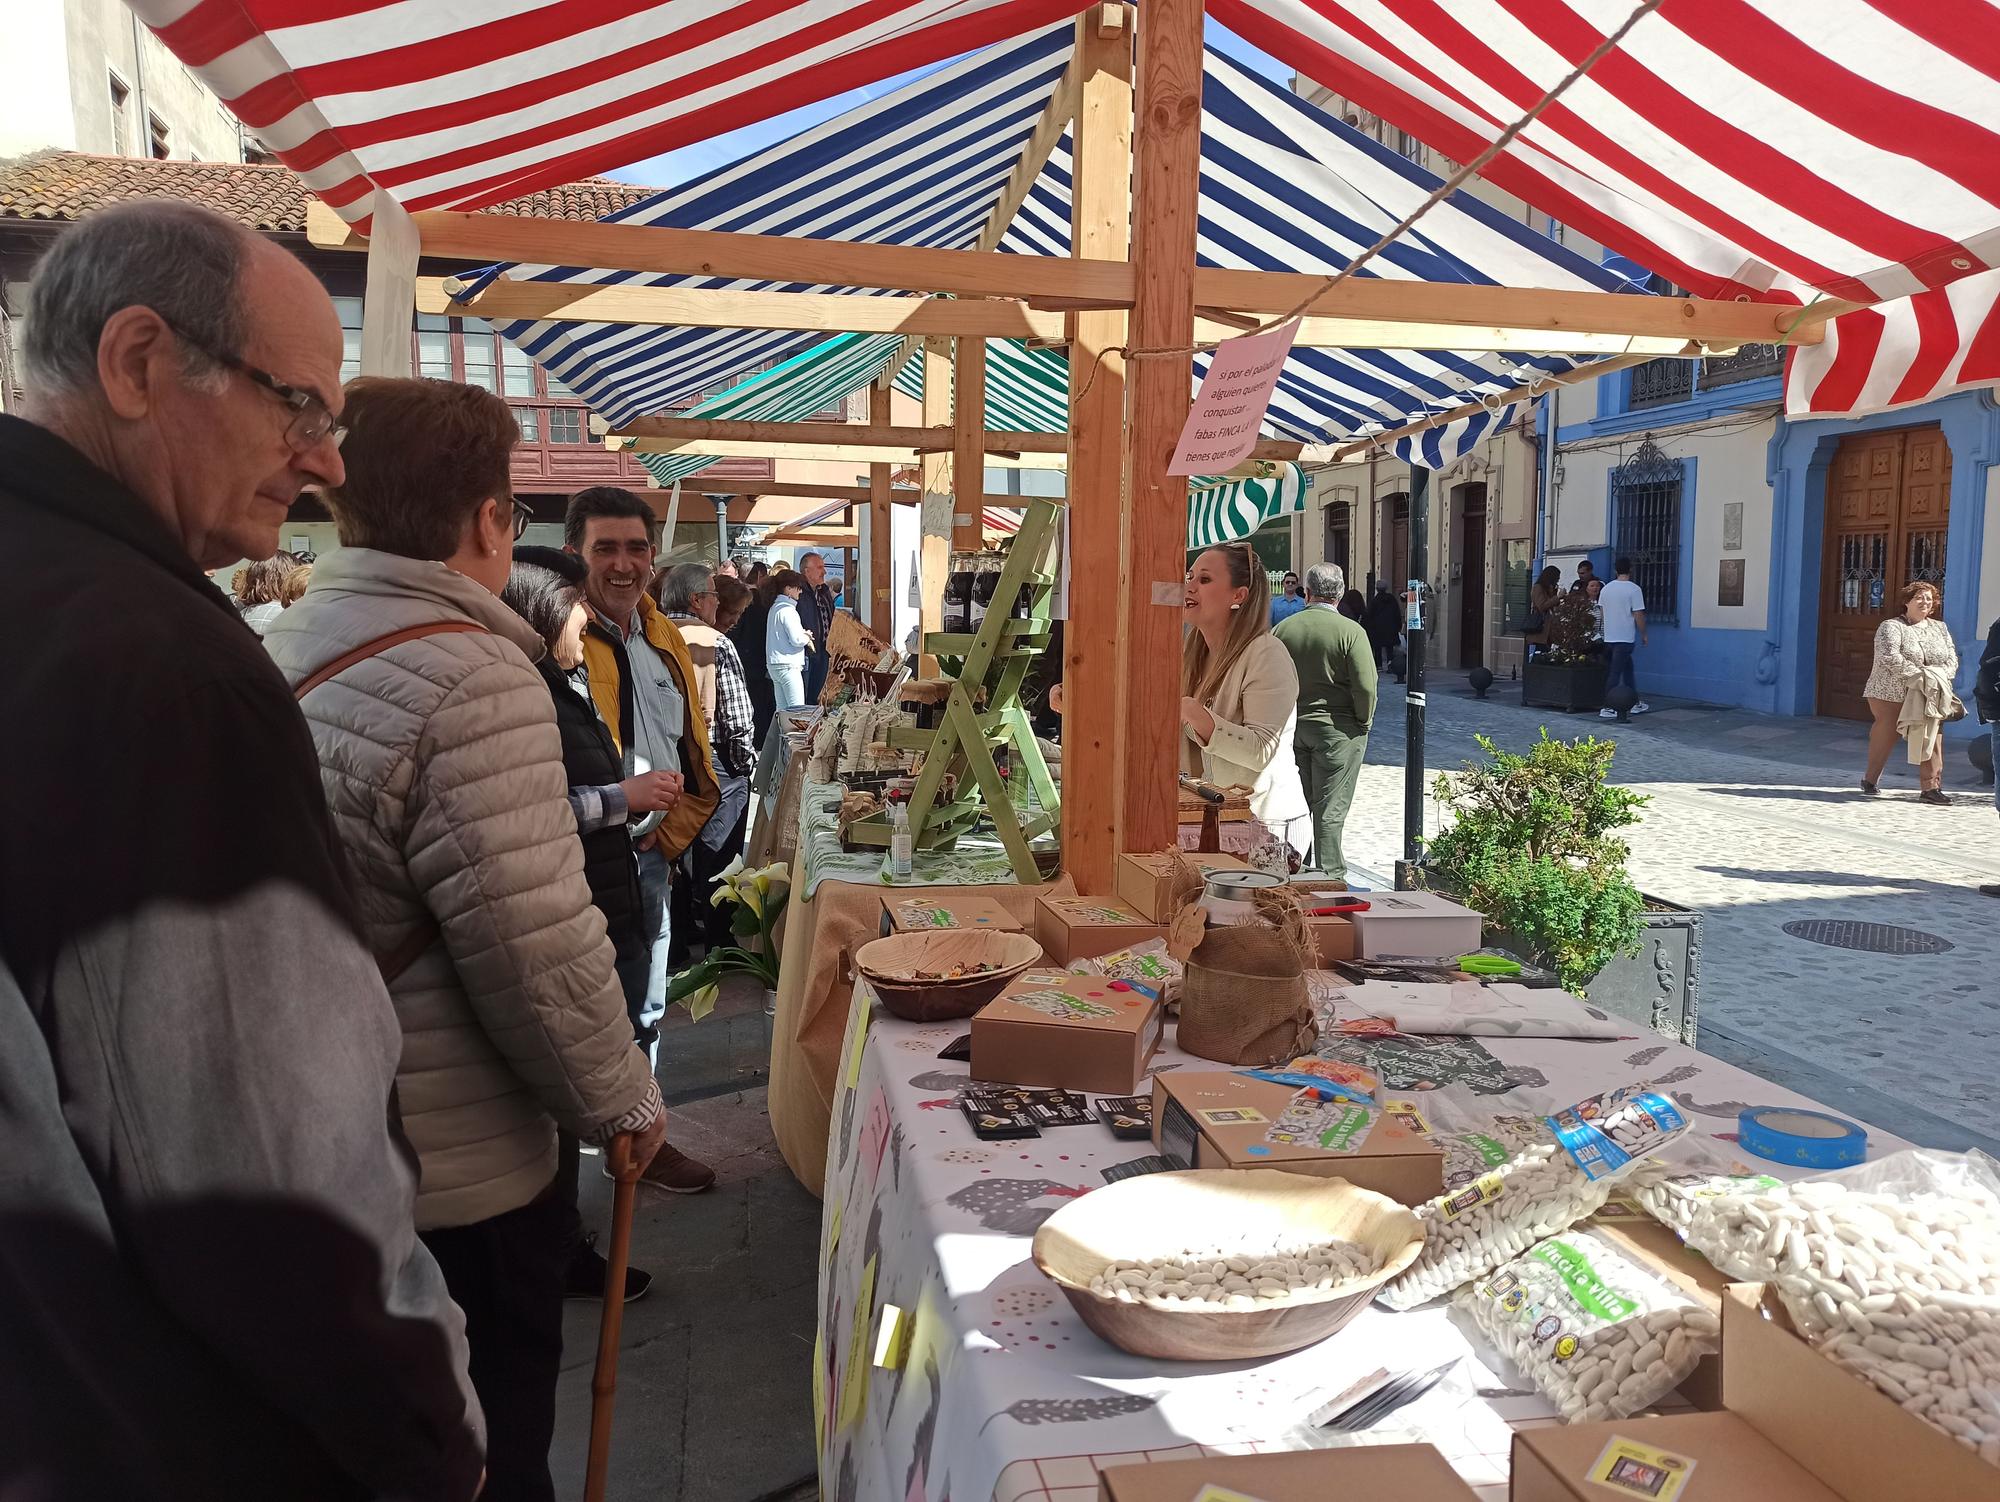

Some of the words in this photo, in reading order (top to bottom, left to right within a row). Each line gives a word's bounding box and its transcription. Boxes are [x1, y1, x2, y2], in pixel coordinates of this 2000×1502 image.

[1219, 369, 1227, 380] si
[1227, 369, 1243, 381] por
[1244, 366, 1253, 377] el
[1210, 387, 1242, 401] alguien
[1194, 428, 1217, 440] fabas
[1217, 426, 1241, 438] FINCA
[1185, 448, 1212, 462] tienes
[1211, 449, 1227, 462] que
[1538, 1242, 1574, 1275] Finca
[1573, 1268, 1590, 1286] La
[1588, 1281, 1626, 1317] Villa
